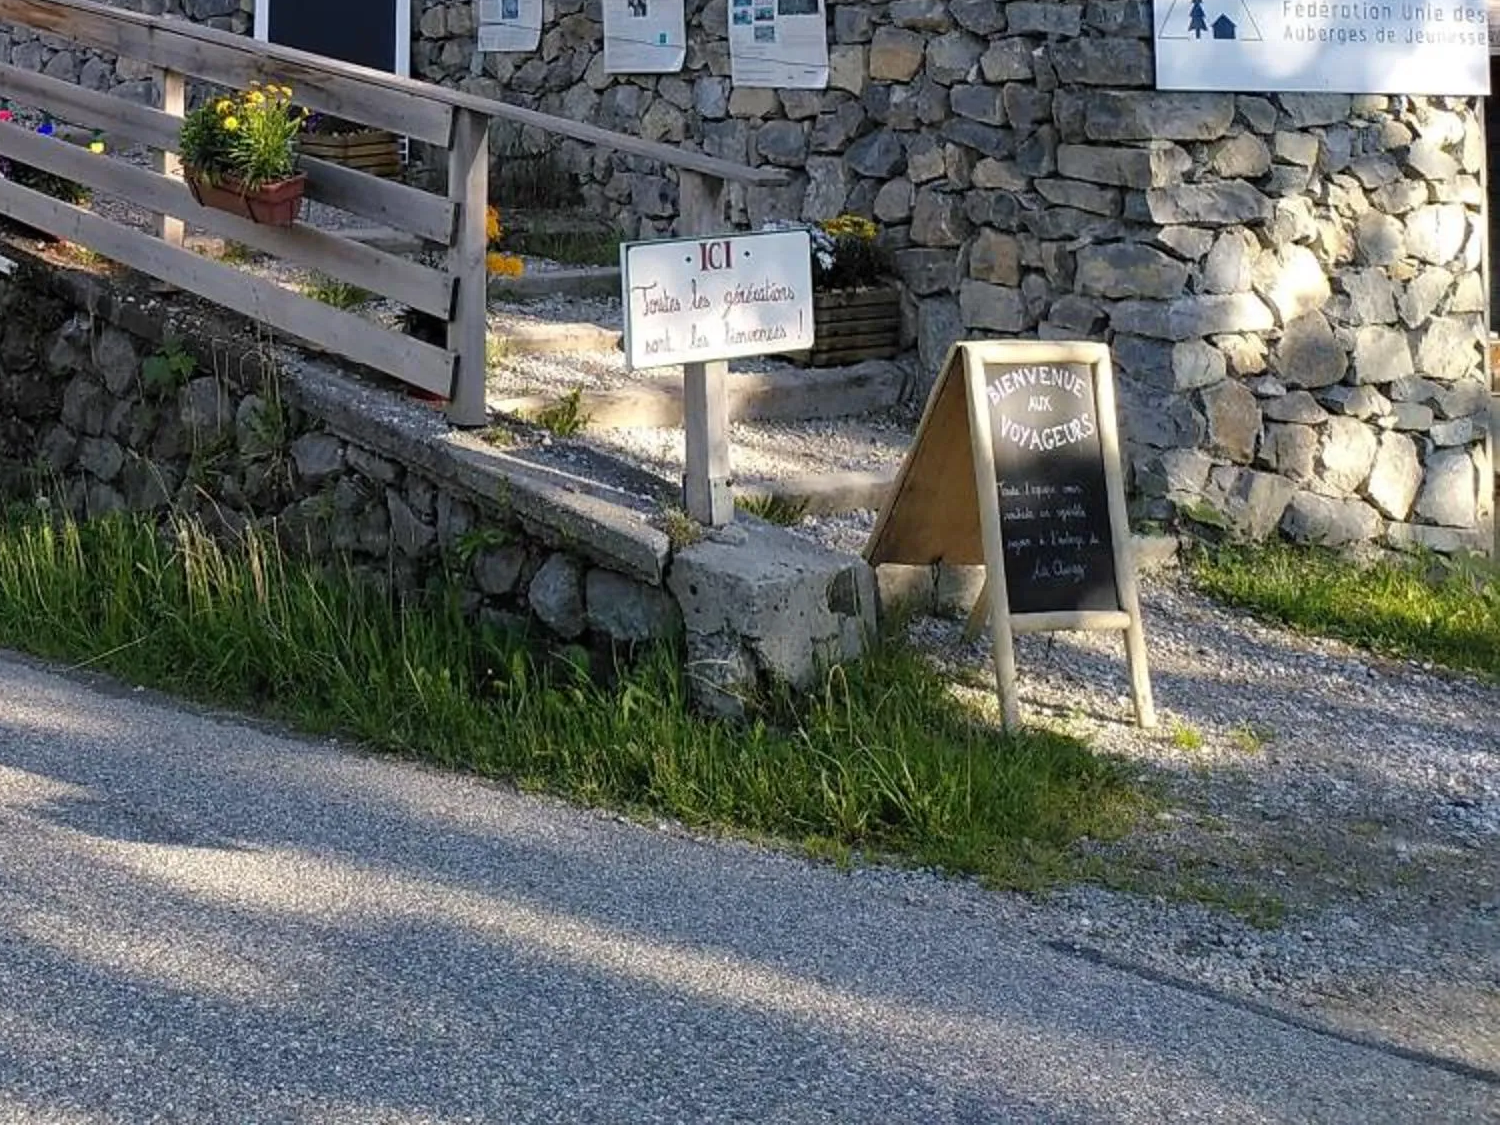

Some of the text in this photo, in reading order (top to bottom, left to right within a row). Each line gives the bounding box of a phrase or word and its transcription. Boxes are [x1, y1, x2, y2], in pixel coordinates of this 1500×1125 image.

[1283, 25, 1367, 45] Auberges
[1377, 27, 1395, 44] de
[699, 241, 732, 271] ICI
[690, 279, 710, 311] les
[987, 366, 1087, 406] BIENVENUE
[1027, 395, 1053, 412] AUX
[999, 413, 1095, 452] VOYAGEURS
